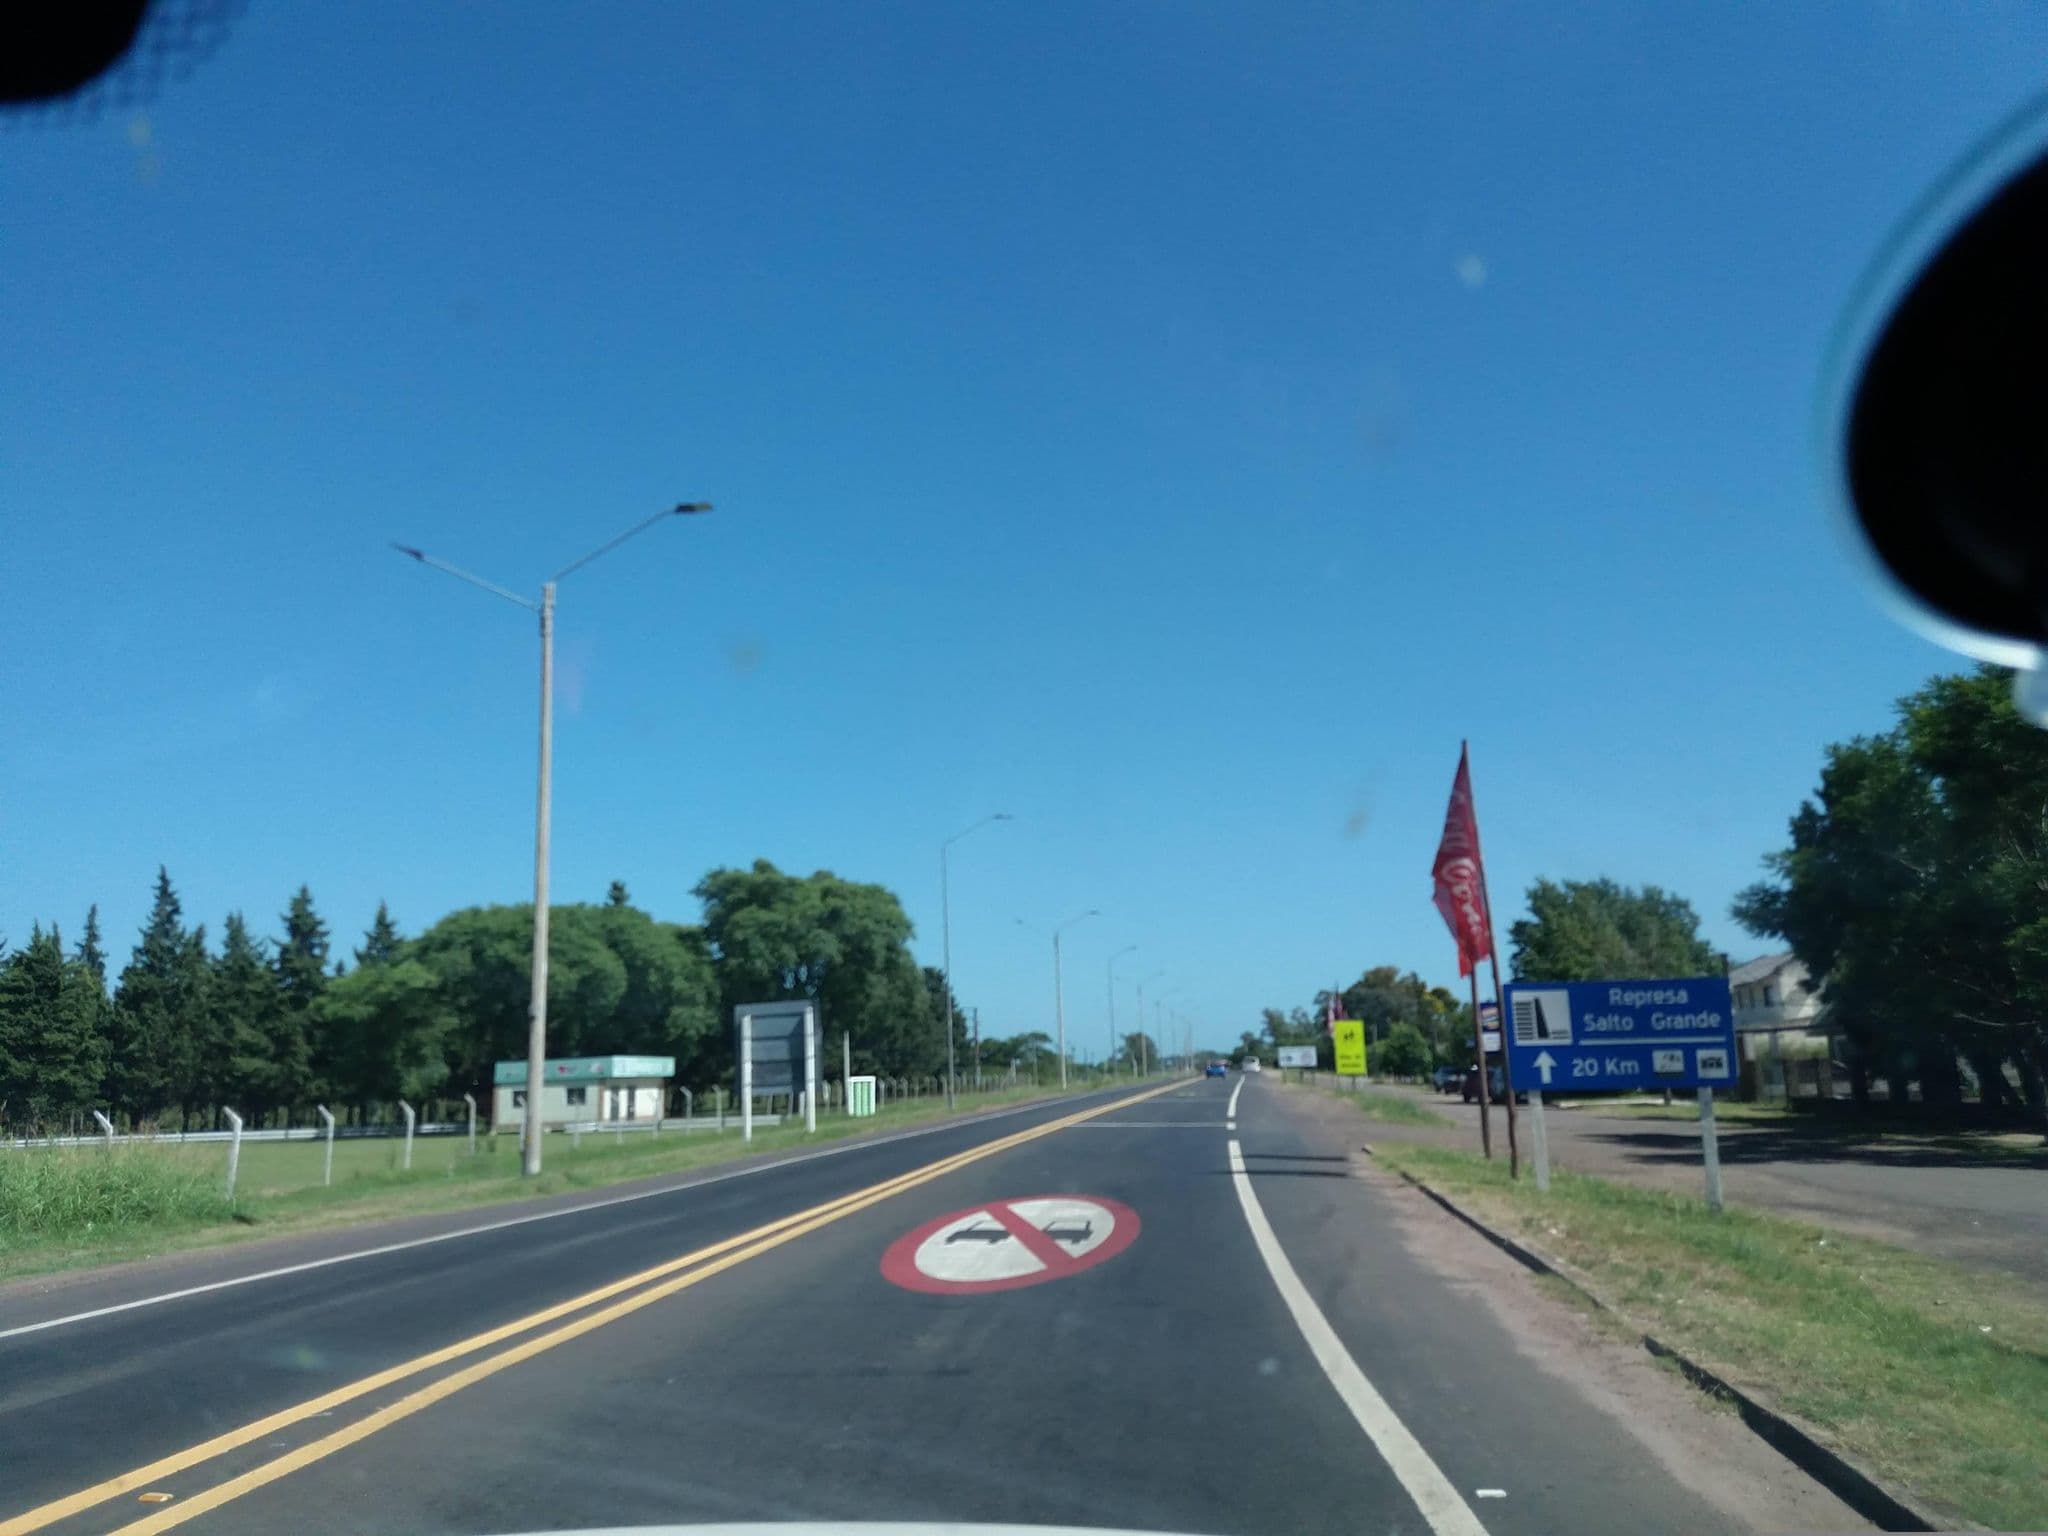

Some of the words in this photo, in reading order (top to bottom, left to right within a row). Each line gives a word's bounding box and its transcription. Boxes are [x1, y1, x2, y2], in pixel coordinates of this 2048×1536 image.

[1609, 988, 1689, 1008] Represa
[1583, 1013, 1634, 1032] Salto
[1651, 1010, 1722, 1030] Grande
[1572, 1058, 1598, 1077] 20
[1605, 1058, 1639, 1076] Km
